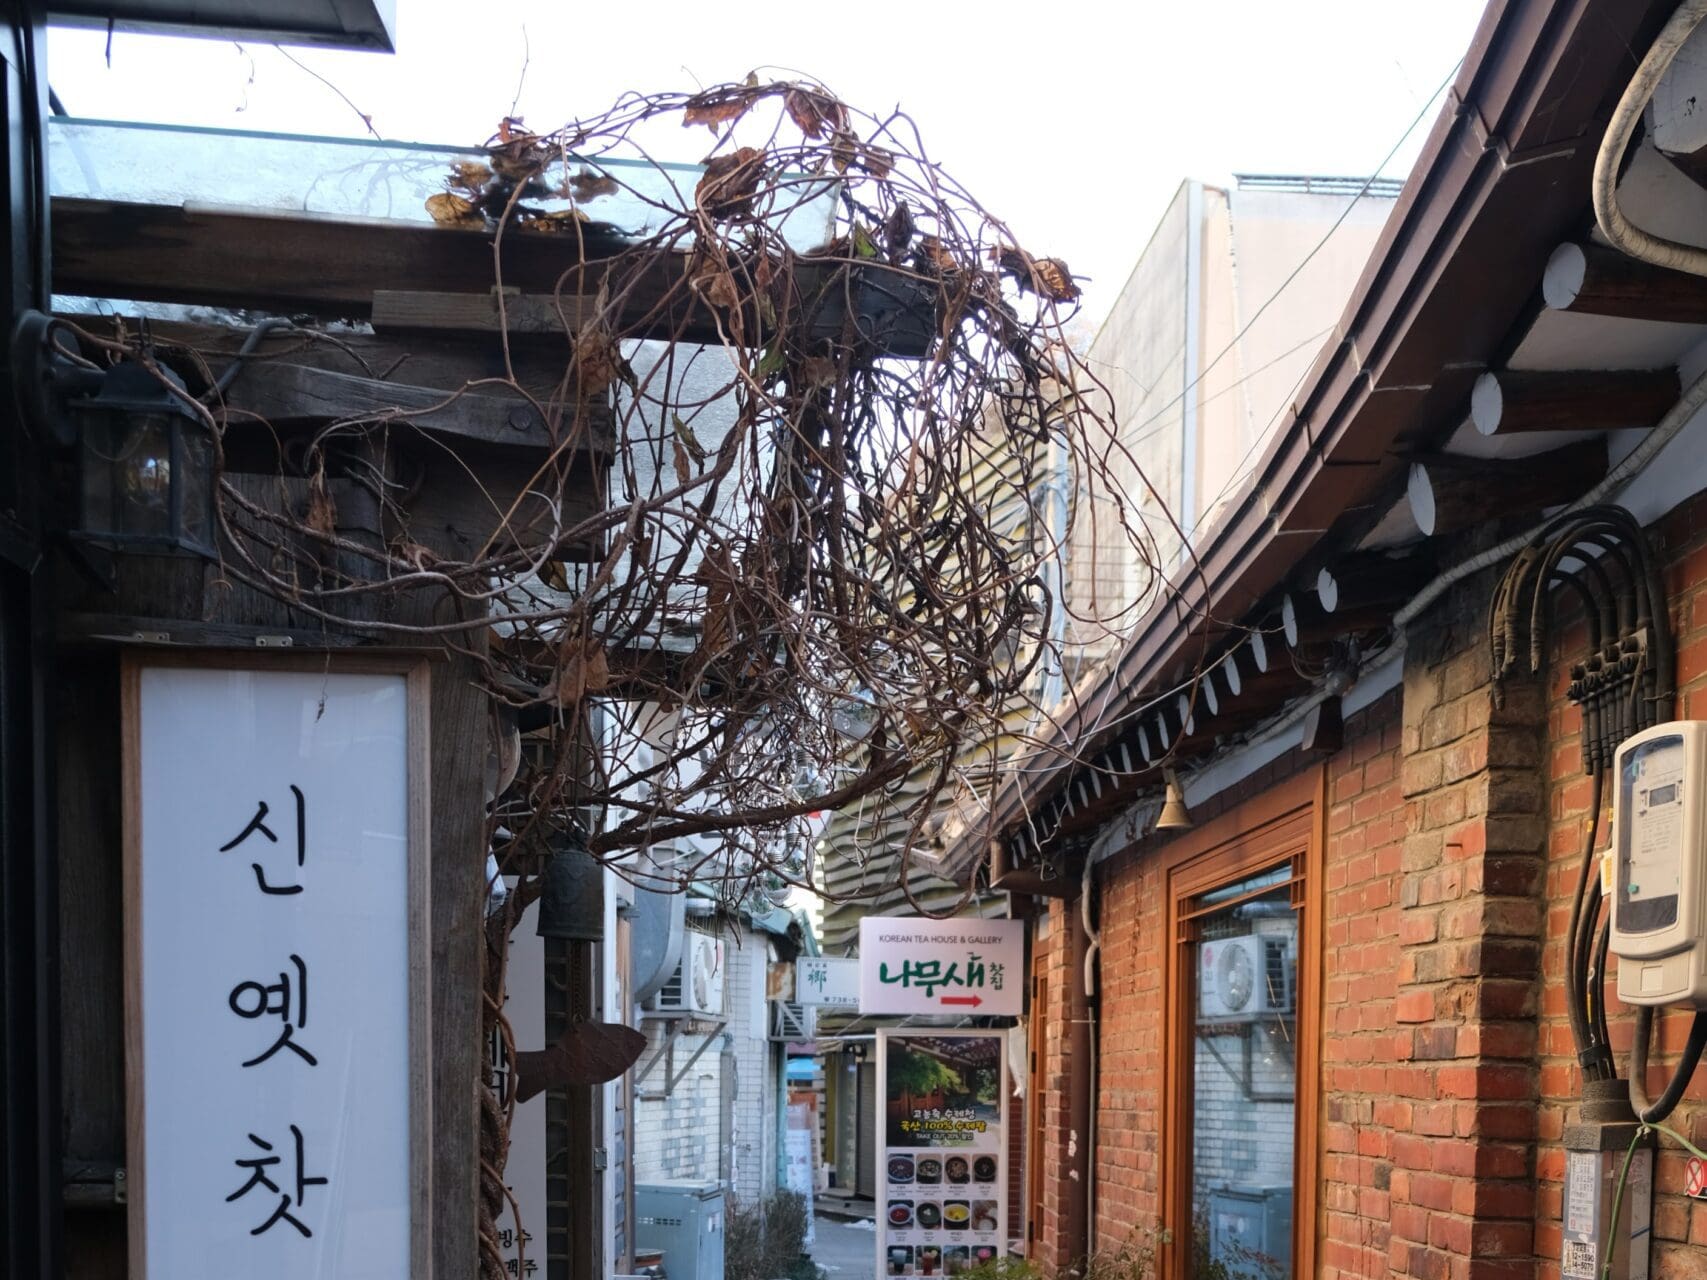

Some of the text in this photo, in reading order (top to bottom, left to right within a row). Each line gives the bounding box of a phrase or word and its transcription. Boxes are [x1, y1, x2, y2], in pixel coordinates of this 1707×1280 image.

[879, 934, 1003, 945] KOREAN TEA HOUSE & GALLERY
[879, 953, 985, 998] 나무새
[925, 1121, 953, 1131] 100%
